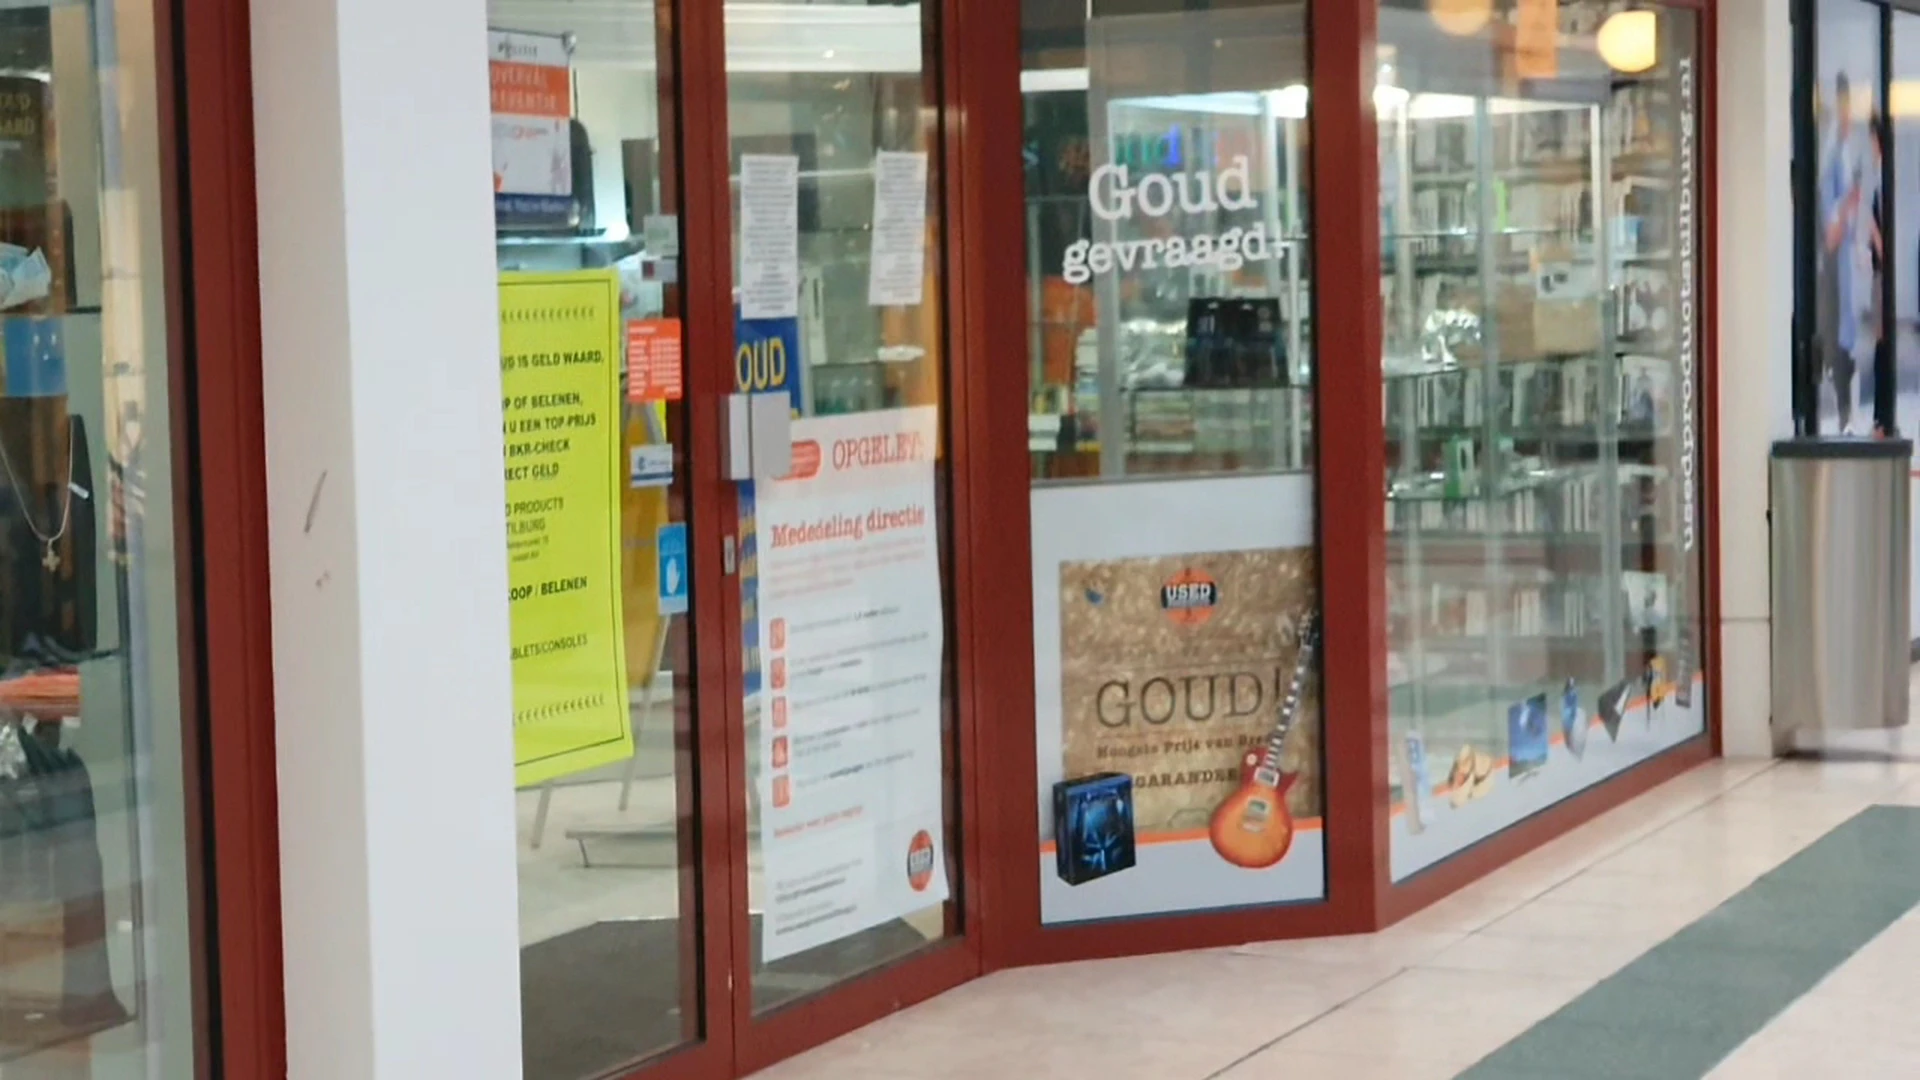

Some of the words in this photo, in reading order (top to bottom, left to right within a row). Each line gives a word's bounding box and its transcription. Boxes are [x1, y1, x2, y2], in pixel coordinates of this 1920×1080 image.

[1089, 154, 1257, 220] Goud
[1063, 218, 1285, 284] gevraagd!
[518, 354, 528, 368] IS
[532, 352, 560, 366] GELD
[514, 395, 528, 409] OF
[520, 418, 541, 432] EEN
[532, 461, 559, 477] GELD
[513, 496, 564, 514] PRODUCTS
[770, 513, 864, 548] Mededeling
[508, 584, 533, 603] OOP
[541, 576, 587, 595] BELENEN
[1166, 582, 1211, 601] USED
[1206, 737, 1233, 749] van
